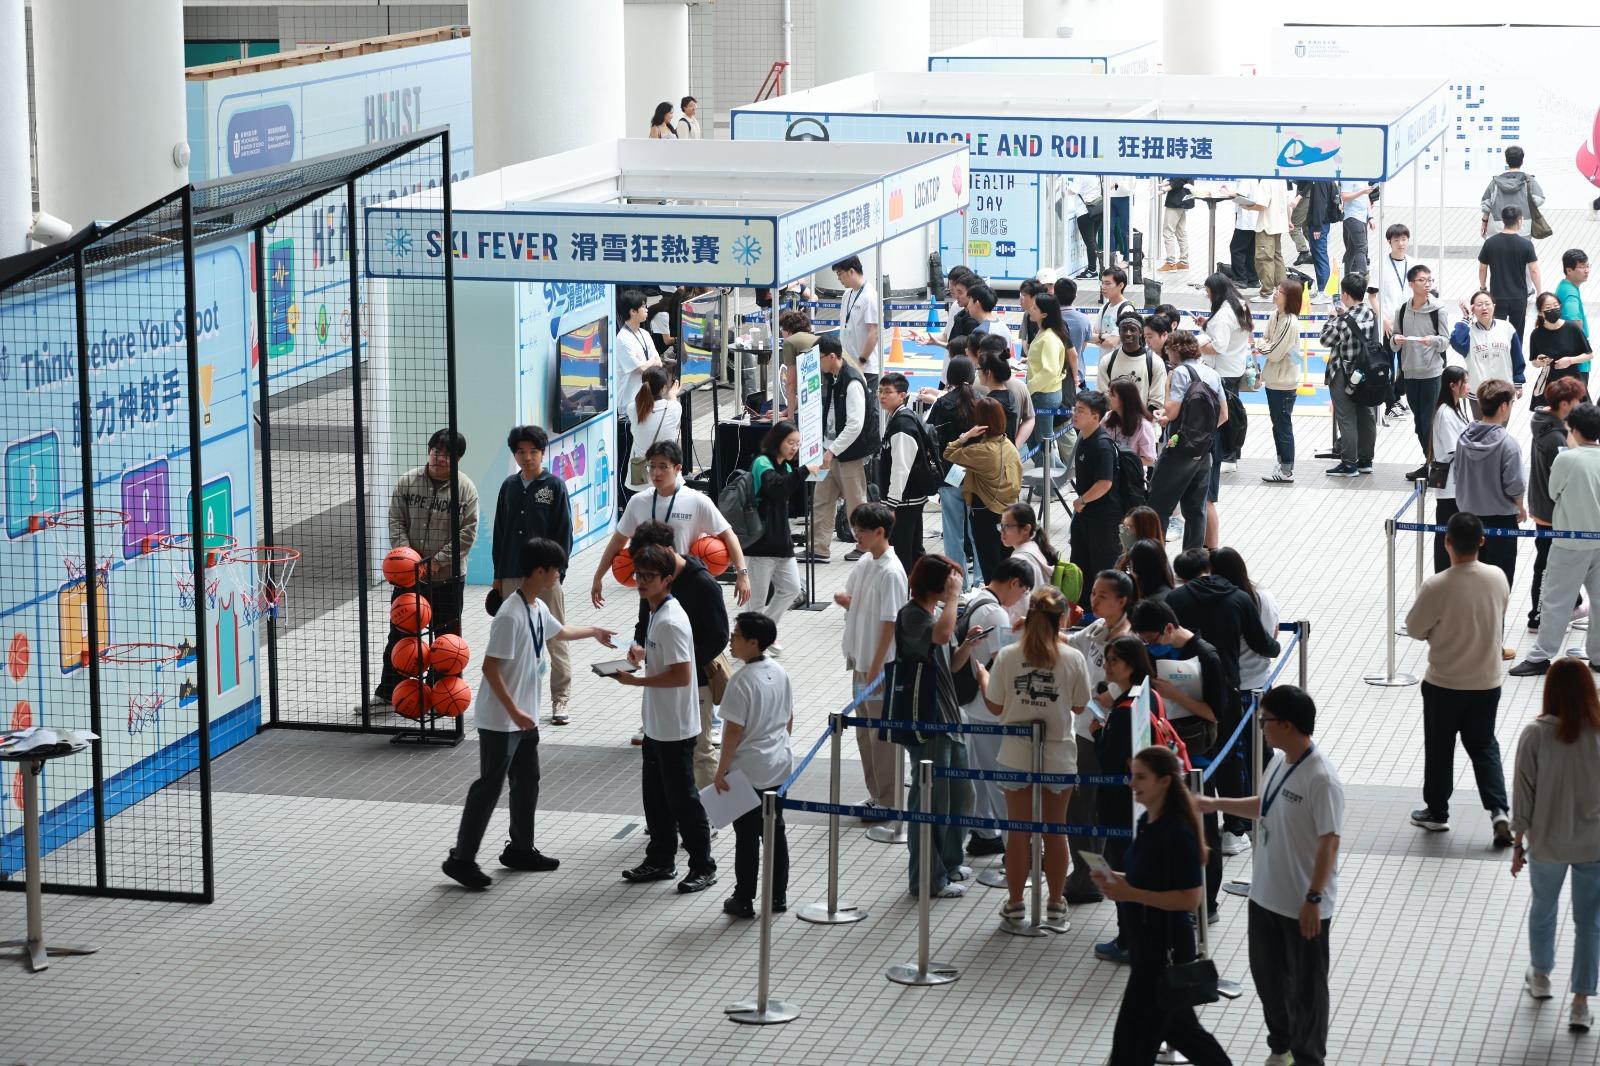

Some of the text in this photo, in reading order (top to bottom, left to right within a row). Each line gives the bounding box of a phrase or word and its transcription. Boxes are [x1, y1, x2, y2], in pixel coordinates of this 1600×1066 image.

[996, 133, 1043, 158] AND
[1051, 135, 1105, 160] ROLL
[1117, 135, 1214, 160] 狂扭時速
[913, 175, 941, 210] LOCKTOP
[976, 196, 1003, 212] DAY
[795, 225, 808, 258] SKI
[809, 217, 832, 253] FEVER
[970, 218, 1008, 236] 2025
[477, 231, 558, 262] FEVER
[570, 232, 721, 265] 滑雪狂熱賽
[20, 340, 75, 392] Think
[85, 328, 136, 370] efore
[138, 317, 171, 354] You
[29, 463, 38, 502] B
[142, 488, 151, 525] C
[207, 505, 215, 540] A
[880, 721, 905, 730] HKUST
[924, 723, 949, 732] HKUST
[970, 725, 995, 734] HKUST
[945, 769, 1115, 784] HKUST HKUST HKUST HKUST
[815, 803, 841, 813] HKUST
[863, 808, 888, 818] HKUST
[911, 812, 937, 822] HKUST
[959, 818, 985, 827] HKUST
[1008, 821, 1034, 831] HKUST
[1056, 825, 1083, 834] HKUST
